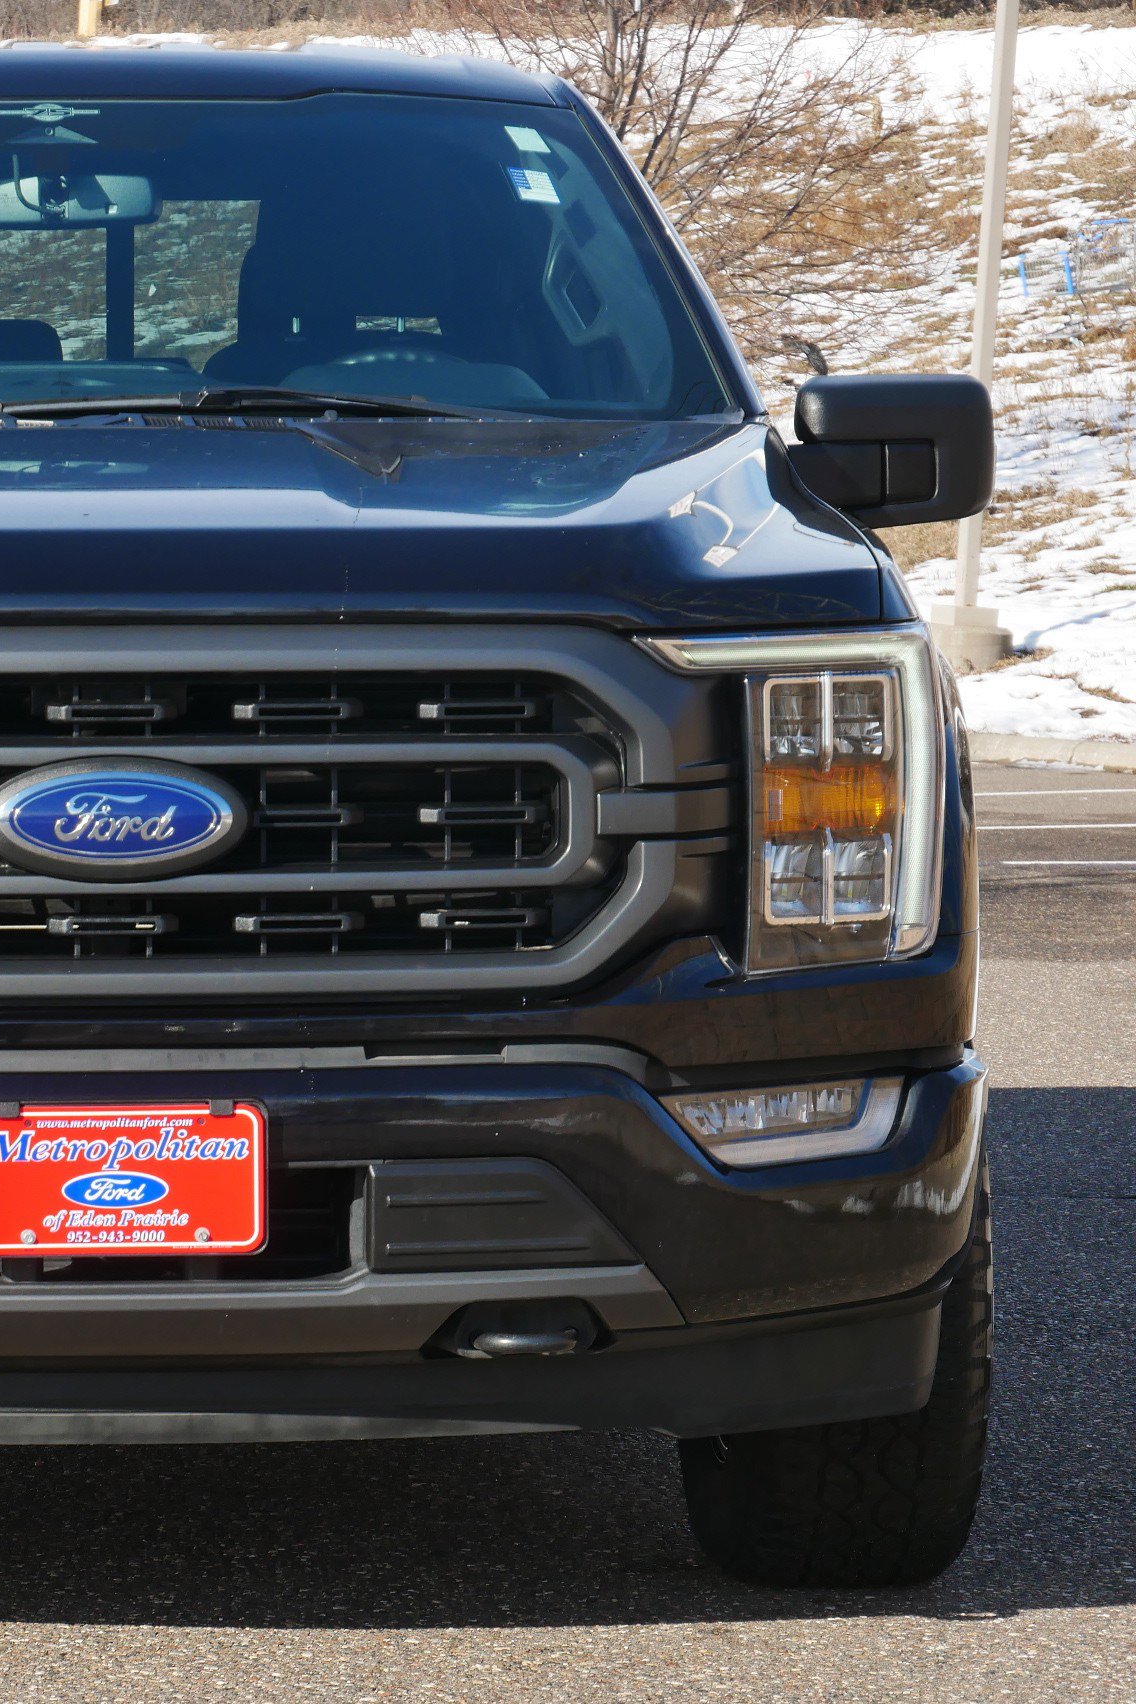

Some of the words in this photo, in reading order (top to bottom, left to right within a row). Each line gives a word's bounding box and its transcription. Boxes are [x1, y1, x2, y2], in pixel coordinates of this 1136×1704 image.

[54, 791, 178, 842] Ford
[36, 1116, 194, 1130] www.metropolitanford.com
[84, 1177, 146, 1201] Ford
[42, 1209, 67, 1232] of
[65, 1209, 115, 1227] Eden
[117, 1209, 190, 1227] Prairie
[66, 1230, 166, 1243] 952-943-9000
